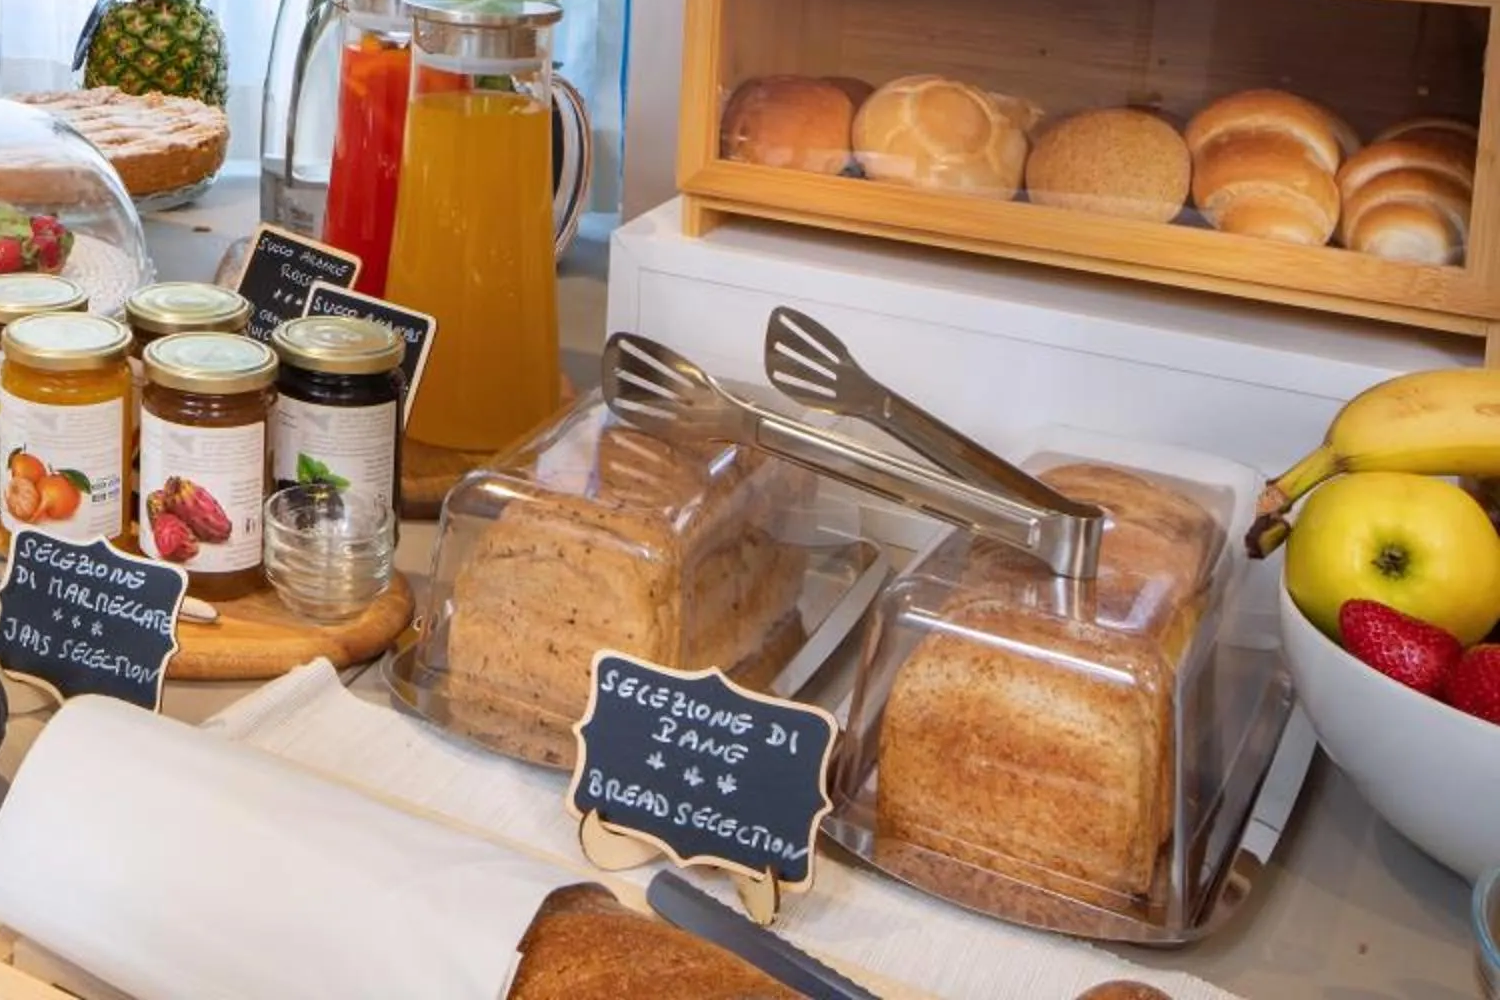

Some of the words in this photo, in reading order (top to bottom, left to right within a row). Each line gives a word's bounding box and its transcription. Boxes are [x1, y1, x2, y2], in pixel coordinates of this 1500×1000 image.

[281, 263, 322, 287] ROSS
[15, 565, 37, 590] DI
[19, 538, 147, 589] SELEZIONE
[3, 617, 51, 656] JAMS
[57, 640, 161, 685] SELECTION
[600, 669, 754, 735] SELEZIONE
[765, 722, 799, 754] DI
[651, 715, 749, 764] PANE
[587, 769, 670, 818] BREAD
[673, 803, 811, 863] SELECTION
